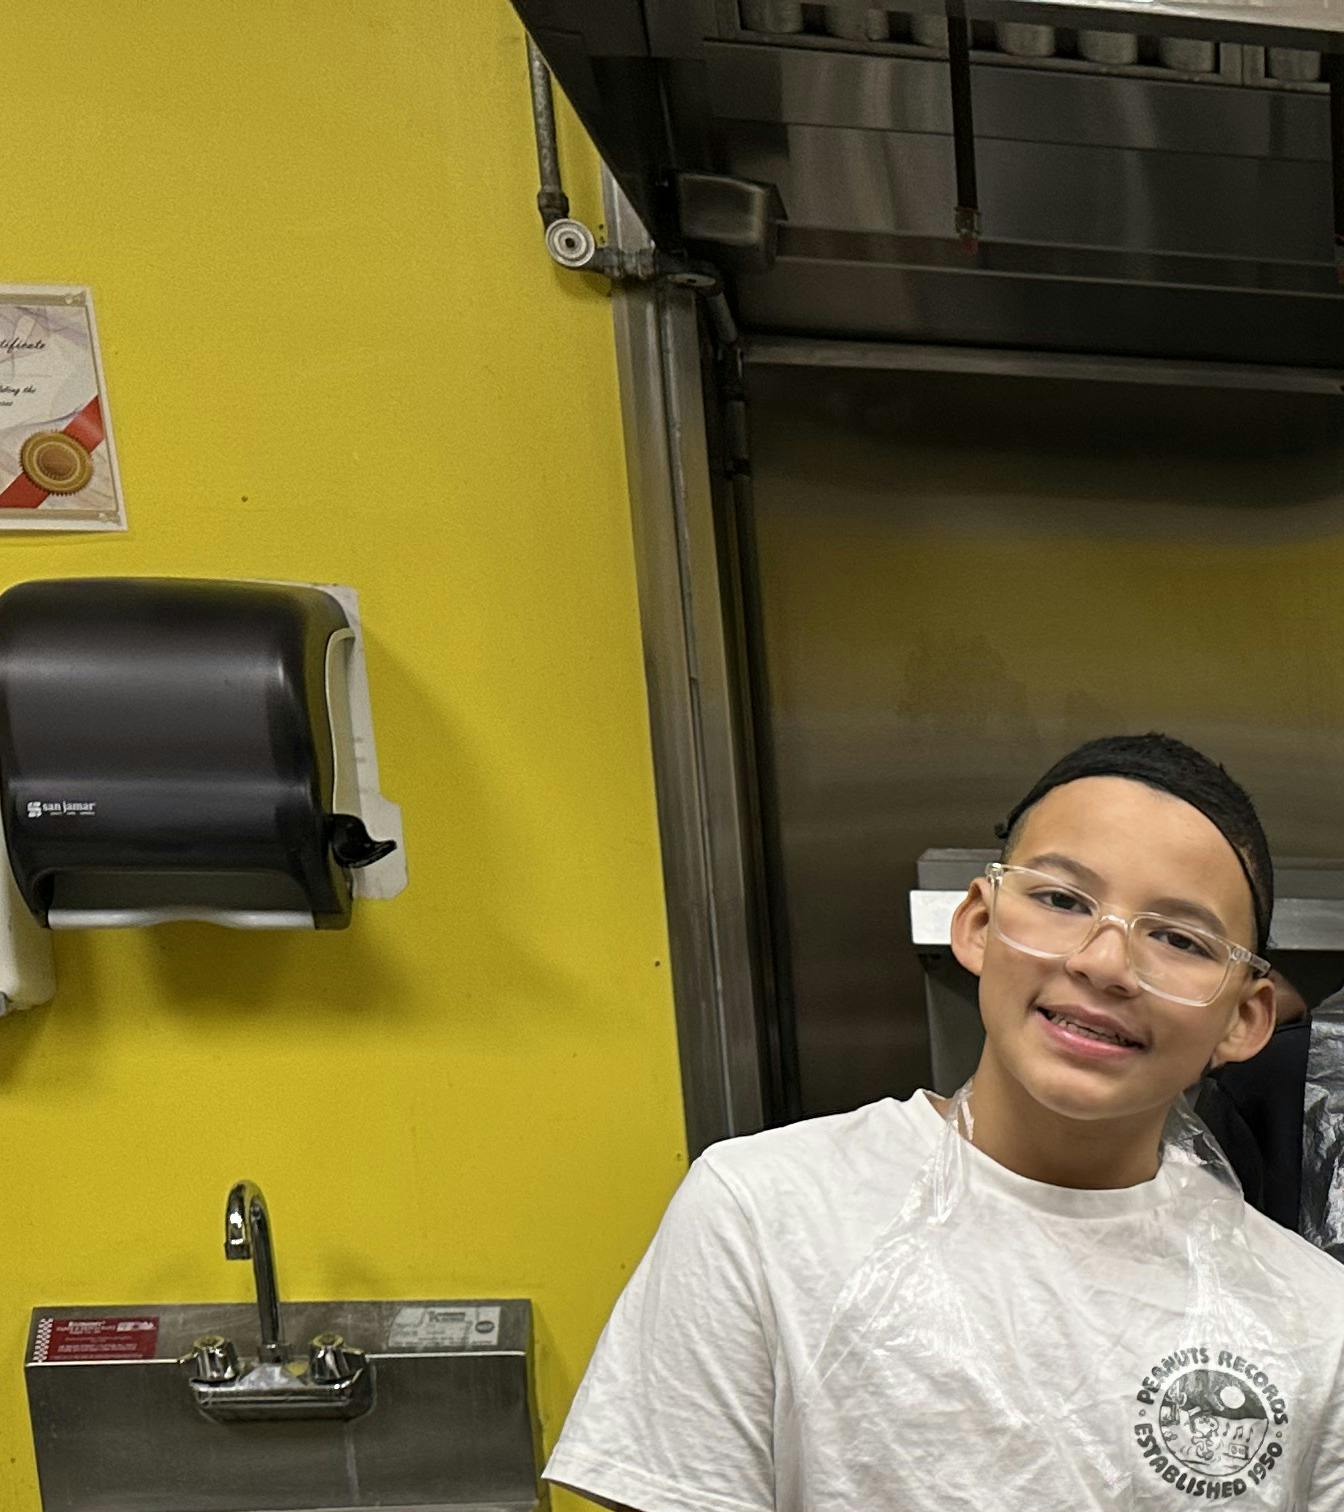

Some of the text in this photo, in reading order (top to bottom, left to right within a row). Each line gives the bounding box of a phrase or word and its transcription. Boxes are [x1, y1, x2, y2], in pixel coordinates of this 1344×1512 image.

[42, 801, 96, 813] san jamar
[1136, 1347, 1289, 1425] PEANUTS RECORDS
[1134, 1422, 1283, 1500] ESTABLISHED 1950
